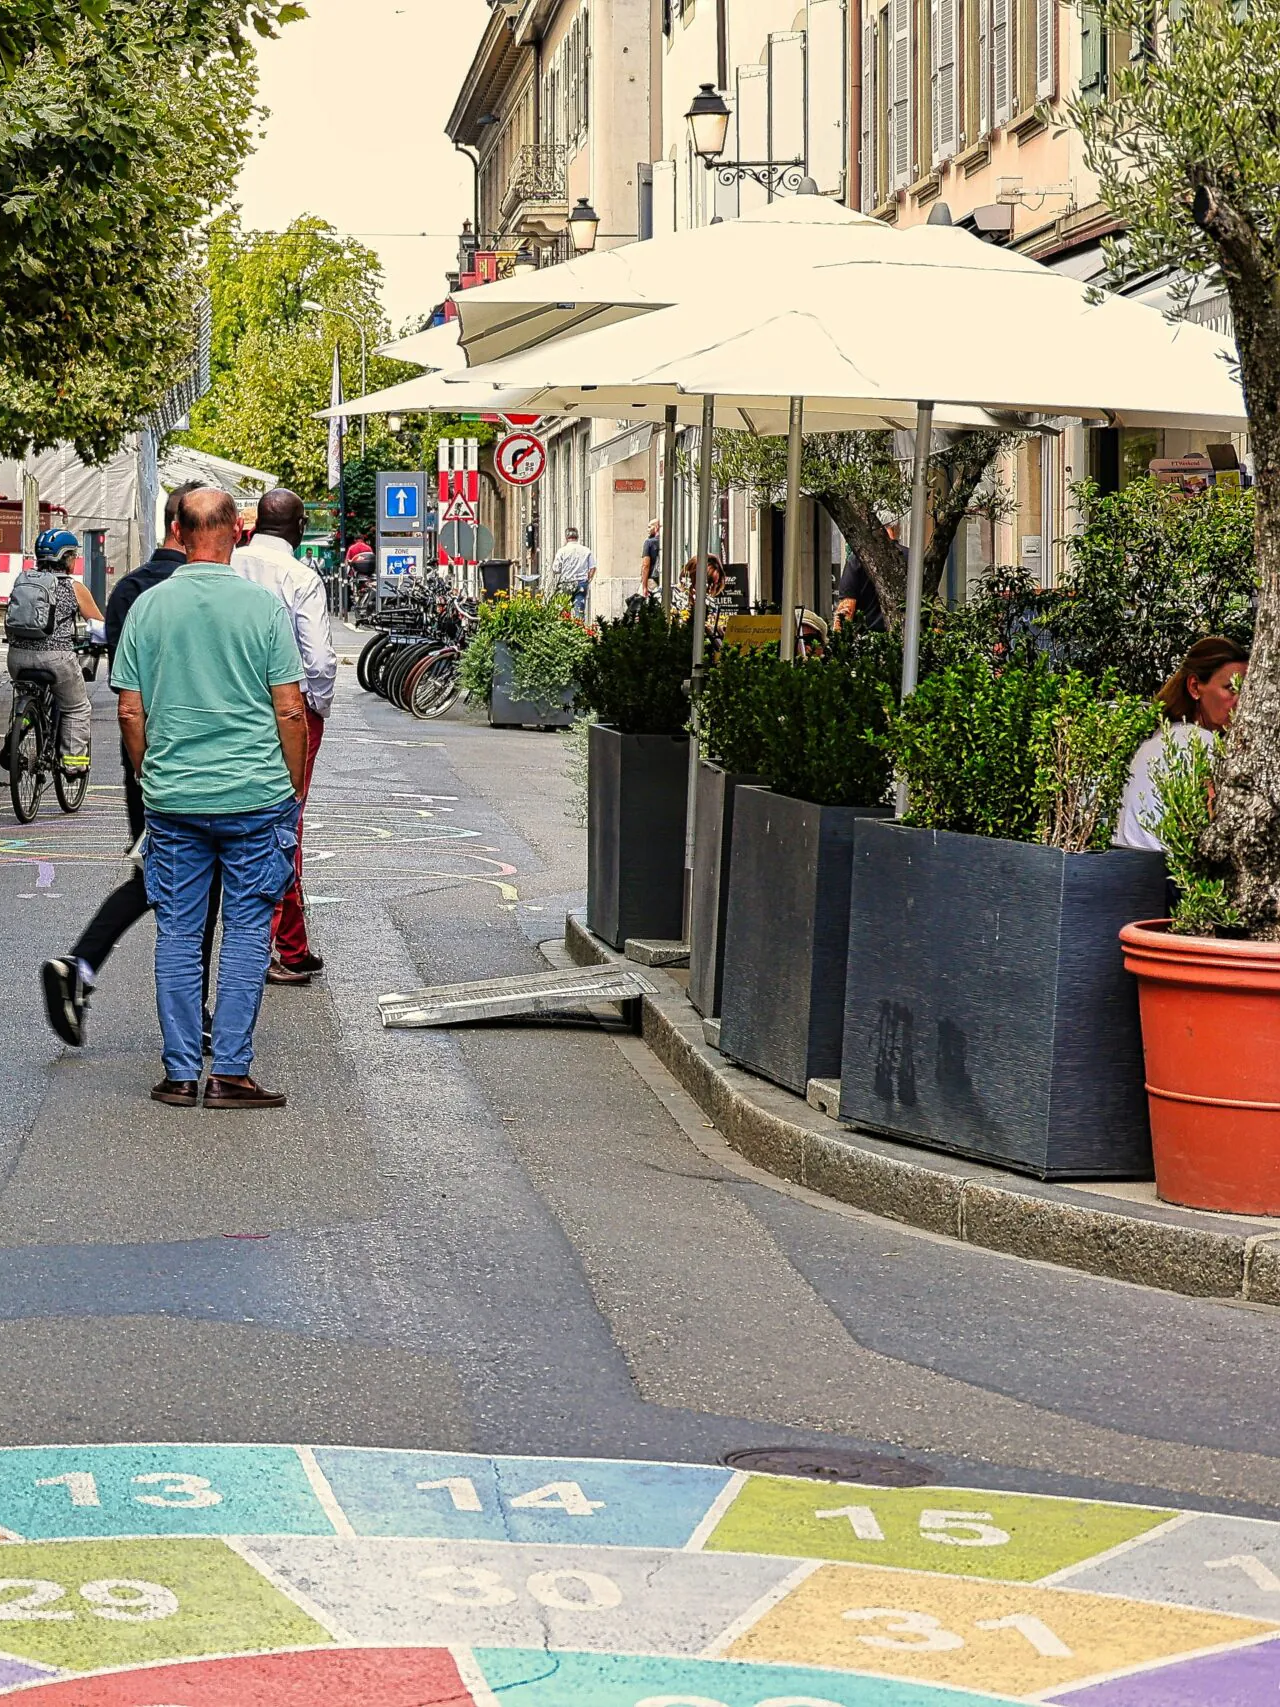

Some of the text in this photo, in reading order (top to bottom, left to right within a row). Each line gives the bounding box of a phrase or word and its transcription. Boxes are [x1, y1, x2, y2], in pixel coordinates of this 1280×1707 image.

[36, 1471, 223, 1509] 13
[416, 1477, 606, 1517] 14
[815, 1505, 1009, 1547] 15
[413, 1565, 623, 1612] 30
[841, 1608, 1074, 1659] 31
